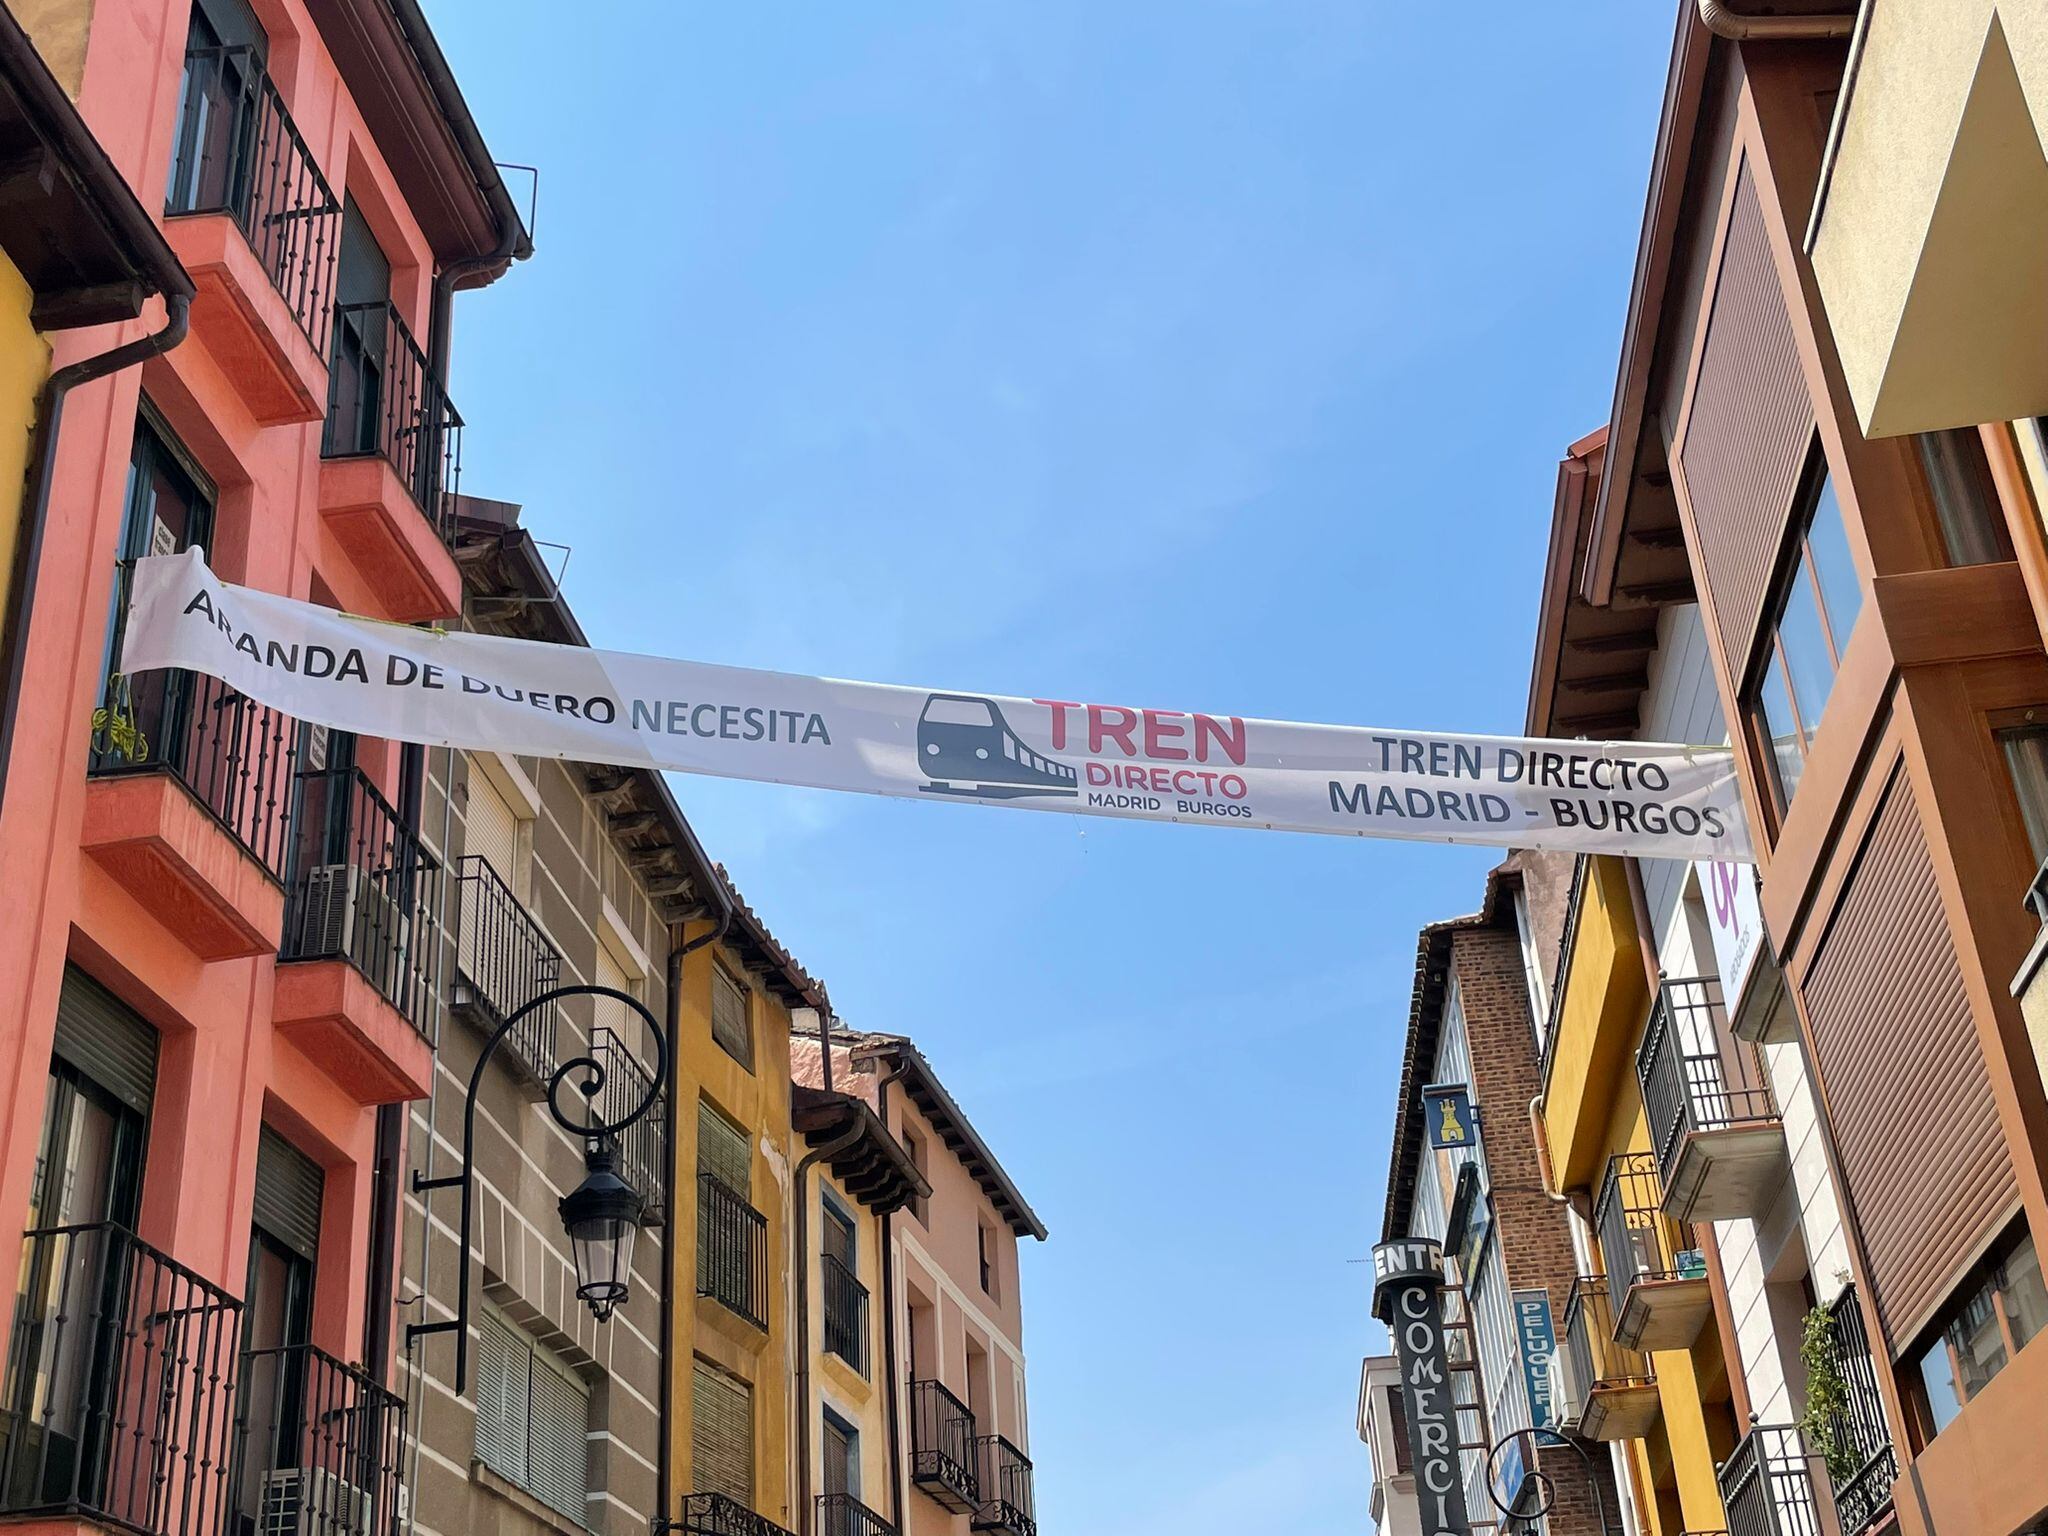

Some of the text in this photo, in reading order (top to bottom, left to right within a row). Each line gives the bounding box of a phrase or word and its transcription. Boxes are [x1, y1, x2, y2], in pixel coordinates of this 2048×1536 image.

[183, 588, 831, 747] ARANDA DE DUERO NECESITA
[1032, 698, 1246, 766] TREN
[1086, 762, 1247, 800] DIRECTO
[1372, 736, 1670, 792] TREN DIRECTO
[1088, 793, 1253, 819] MADRID BURGOS
[1328, 780, 1511, 823] MADRID
[1551, 798, 1726, 839] BURGOS
[1401, 1287, 1458, 1536] COMERCI
